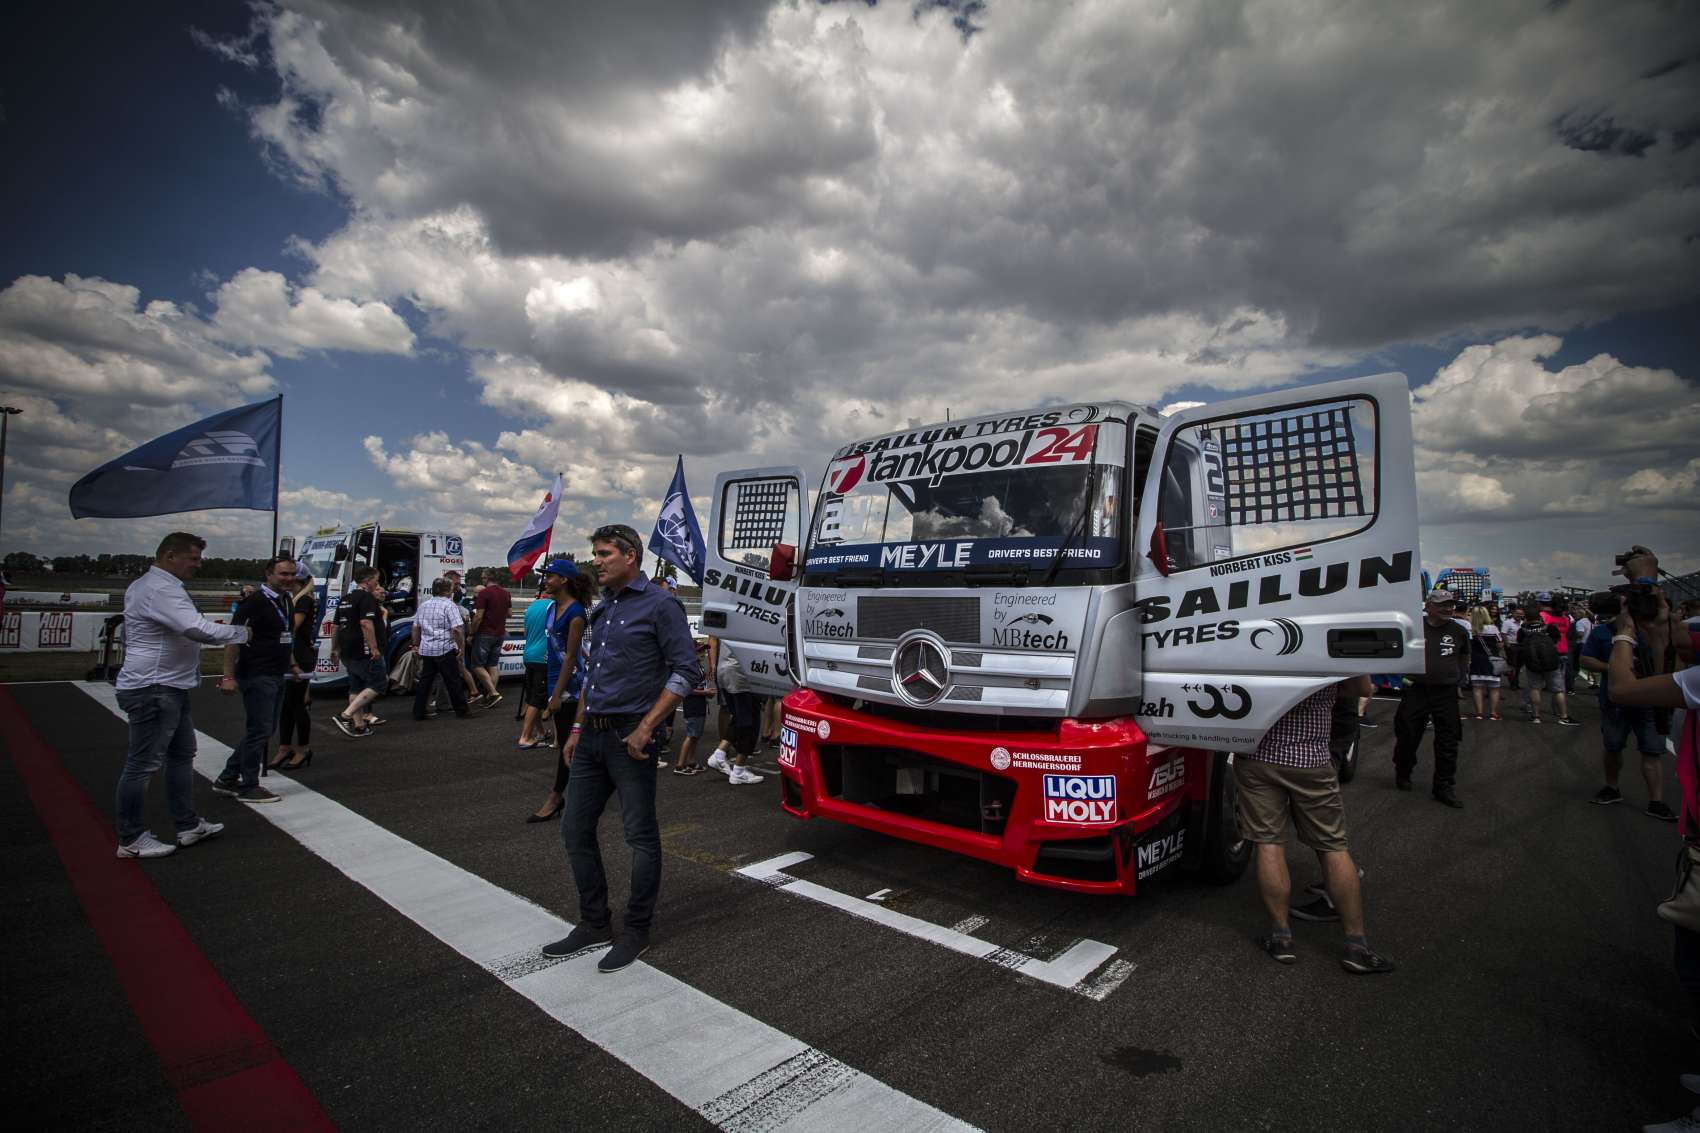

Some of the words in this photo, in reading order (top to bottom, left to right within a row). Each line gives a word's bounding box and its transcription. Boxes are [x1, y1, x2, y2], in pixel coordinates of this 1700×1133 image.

[855, 426, 967, 455] SAILUN
[977, 412, 1061, 436] TYRES
[829, 556, 845, 564] BEST
[845, 555, 869, 563] FRIEND
[880, 542, 974, 568] MEYLE
[988, 550, 1031, 559] DRIVER'S
[1033, 549, 1059, 558] BEST
[1062, 549, 1102, 559] FRIEND
[1210, 558, 1261, 577] NORBERT
[1264, 552, 1291, 567] KISS
[808, 591, 847, 603] Engineered
[1136, 550, 1413, 624] SAILUN
[807, 603, 815, 615] by
[994, 592, 1057, 607] Engineered
[736, 602, 780, 625] TYRES
[993, 607, 1007, 624] by
[804, 620, 854, 638] MBtech
[992, 628, 1068, 649] MBtech
[1141, 619, 1240, 651] TYRES
[751, 660, 768, 674] t&h
[1012, 752, 1082, 763] SCHLOSSBRAUEREI
[1012, 761, 1082, 771] HERRNGIERSDORF
[1148, 756, 1184, 790] ASUS
[1047, 777, 1113, 799] LIQUI
[1049, 799, 1115, 821] MOLY
[1137, 828, 1187, 869] MEYLE
